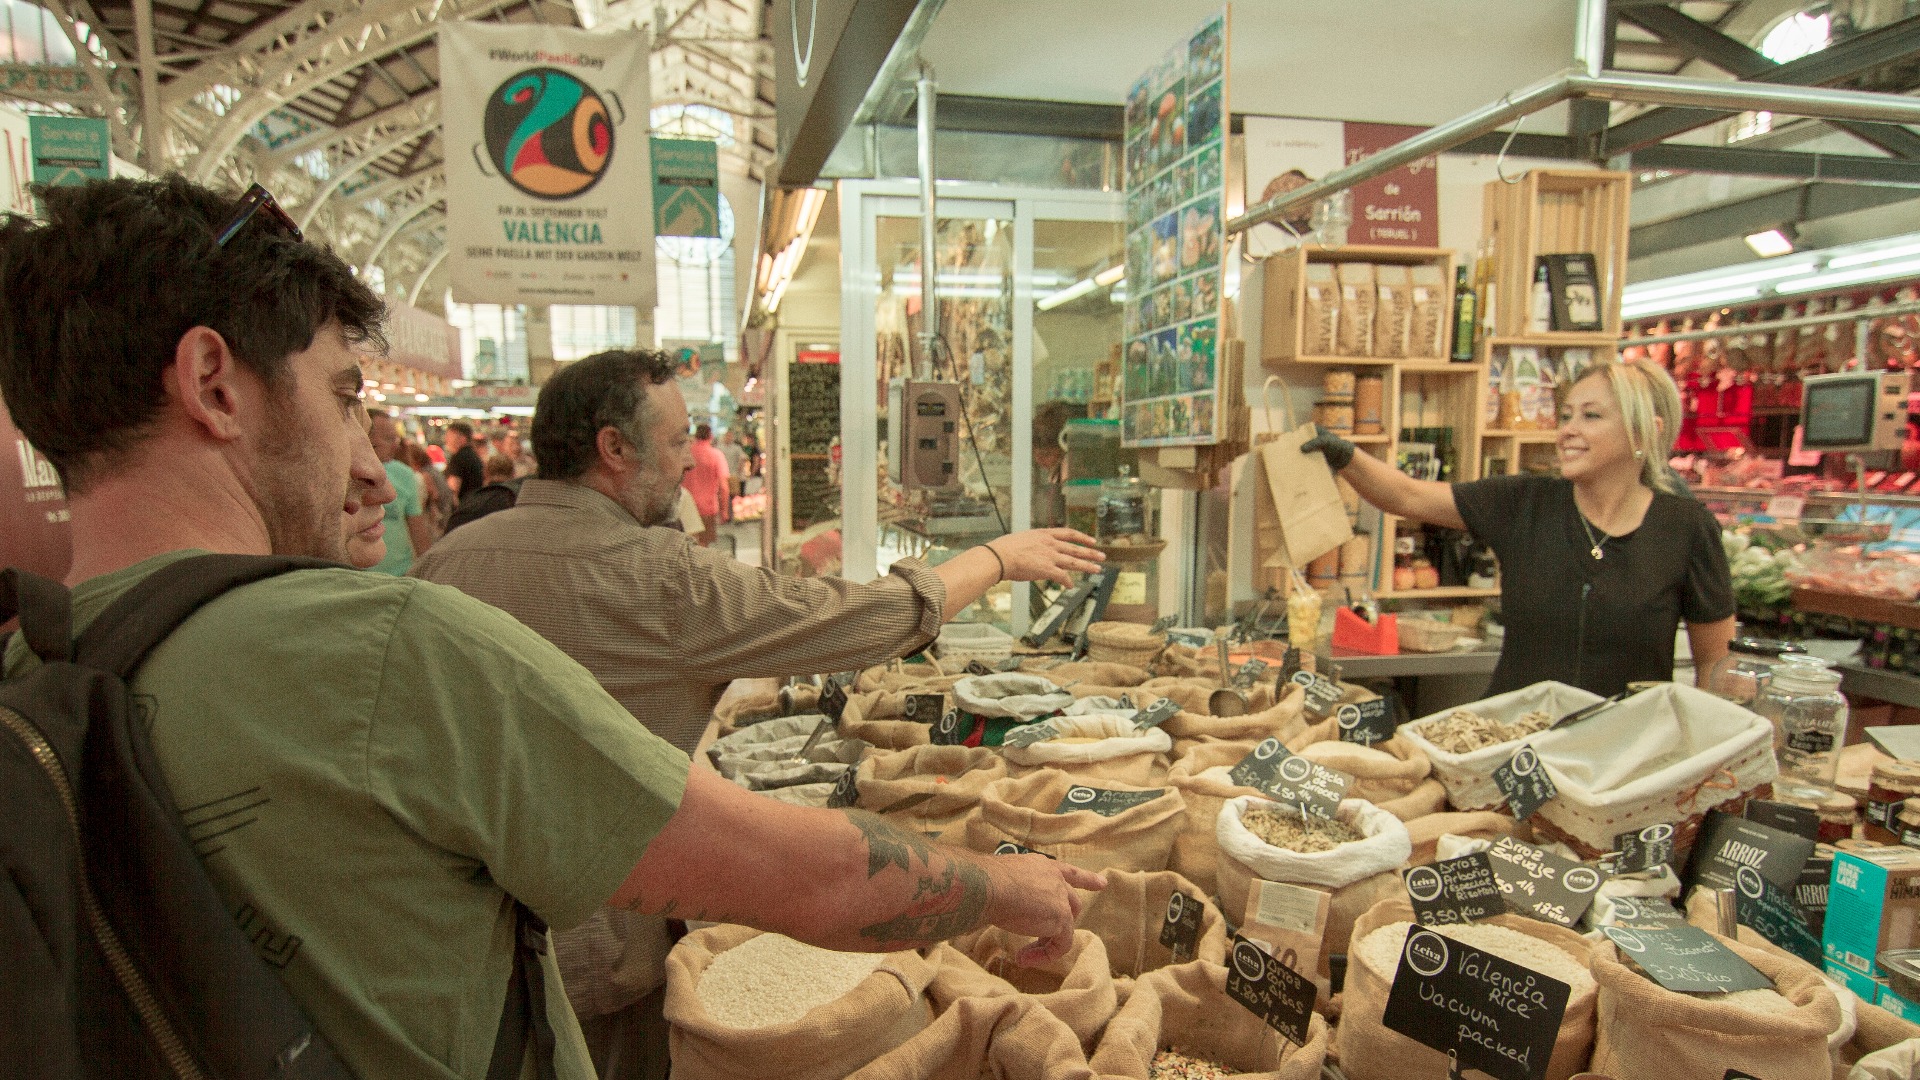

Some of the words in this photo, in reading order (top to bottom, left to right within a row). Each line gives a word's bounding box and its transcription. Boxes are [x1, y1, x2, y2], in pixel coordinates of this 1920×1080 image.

[1383, 183, 1401, 196] de
[1364, 203, 1422, 223] Sarrión
[503, 218, 603, 244] VALÈNCIA
[1496, 836, 1544, 862] Arroz
[1717, 838, 1768, 870] ARROZ
[1438, 856, 1480, 875] Arroz
[1794, 883, 1829, 907] ARRO
[1238, 951, 1260, 969] Leiva
[1413, 943, 1442, 962] Leiva
[1458, 951, 1548, 1011] Valencia
[1488, 987, 1531, 1020] Rice
